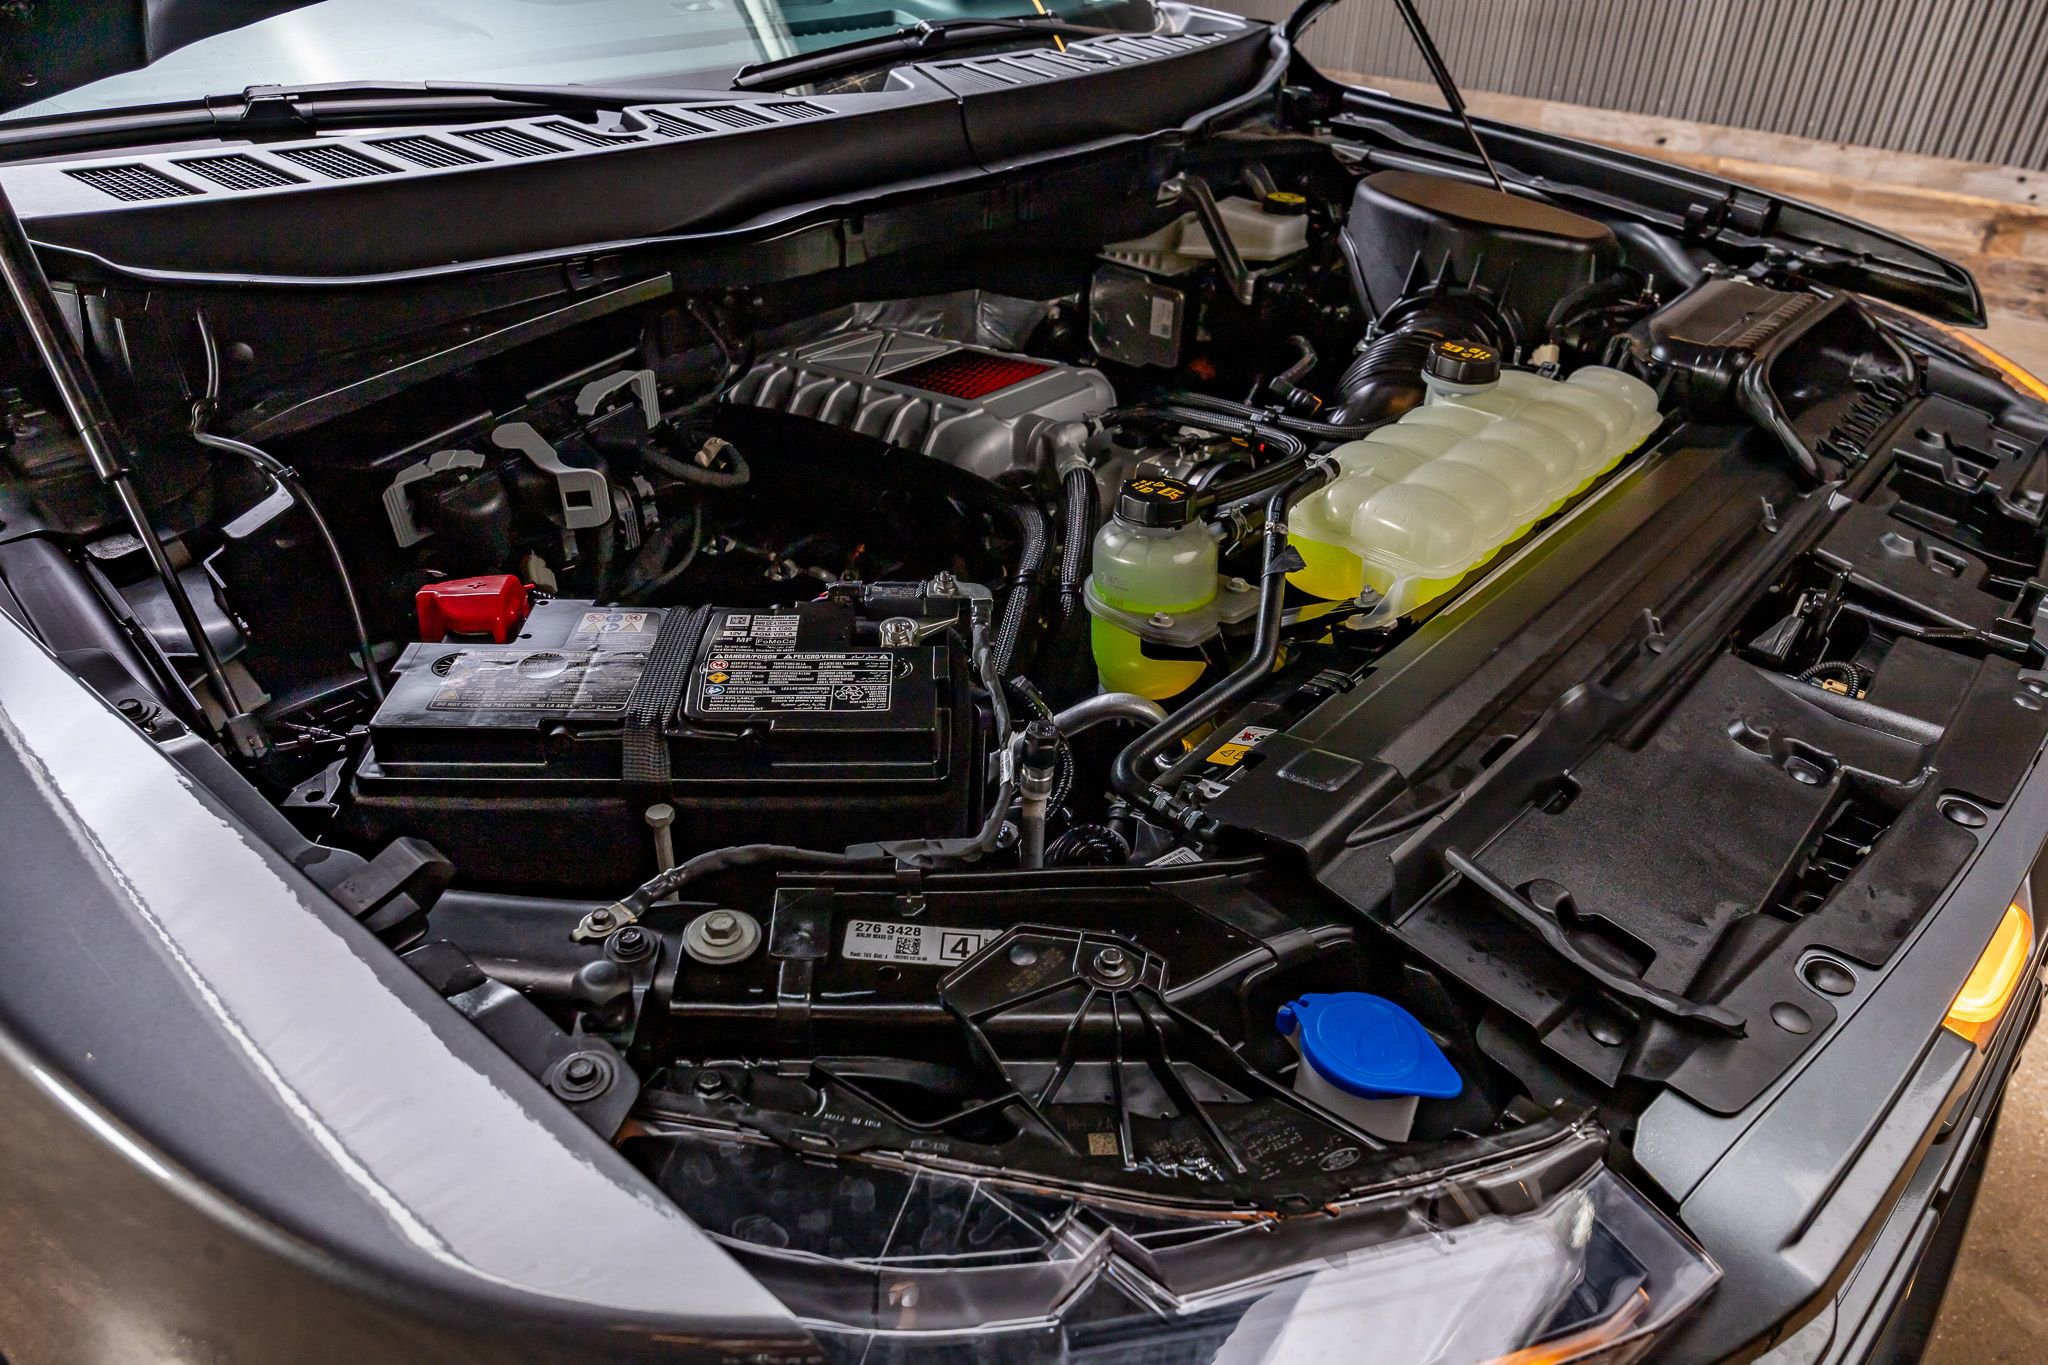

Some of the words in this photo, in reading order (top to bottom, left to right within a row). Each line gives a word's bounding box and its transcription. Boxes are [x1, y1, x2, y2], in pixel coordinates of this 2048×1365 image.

[855, 922, 881, 933] 276
[887, 925, 921, 936] 3428
[951, 937, 970, 958] 4
